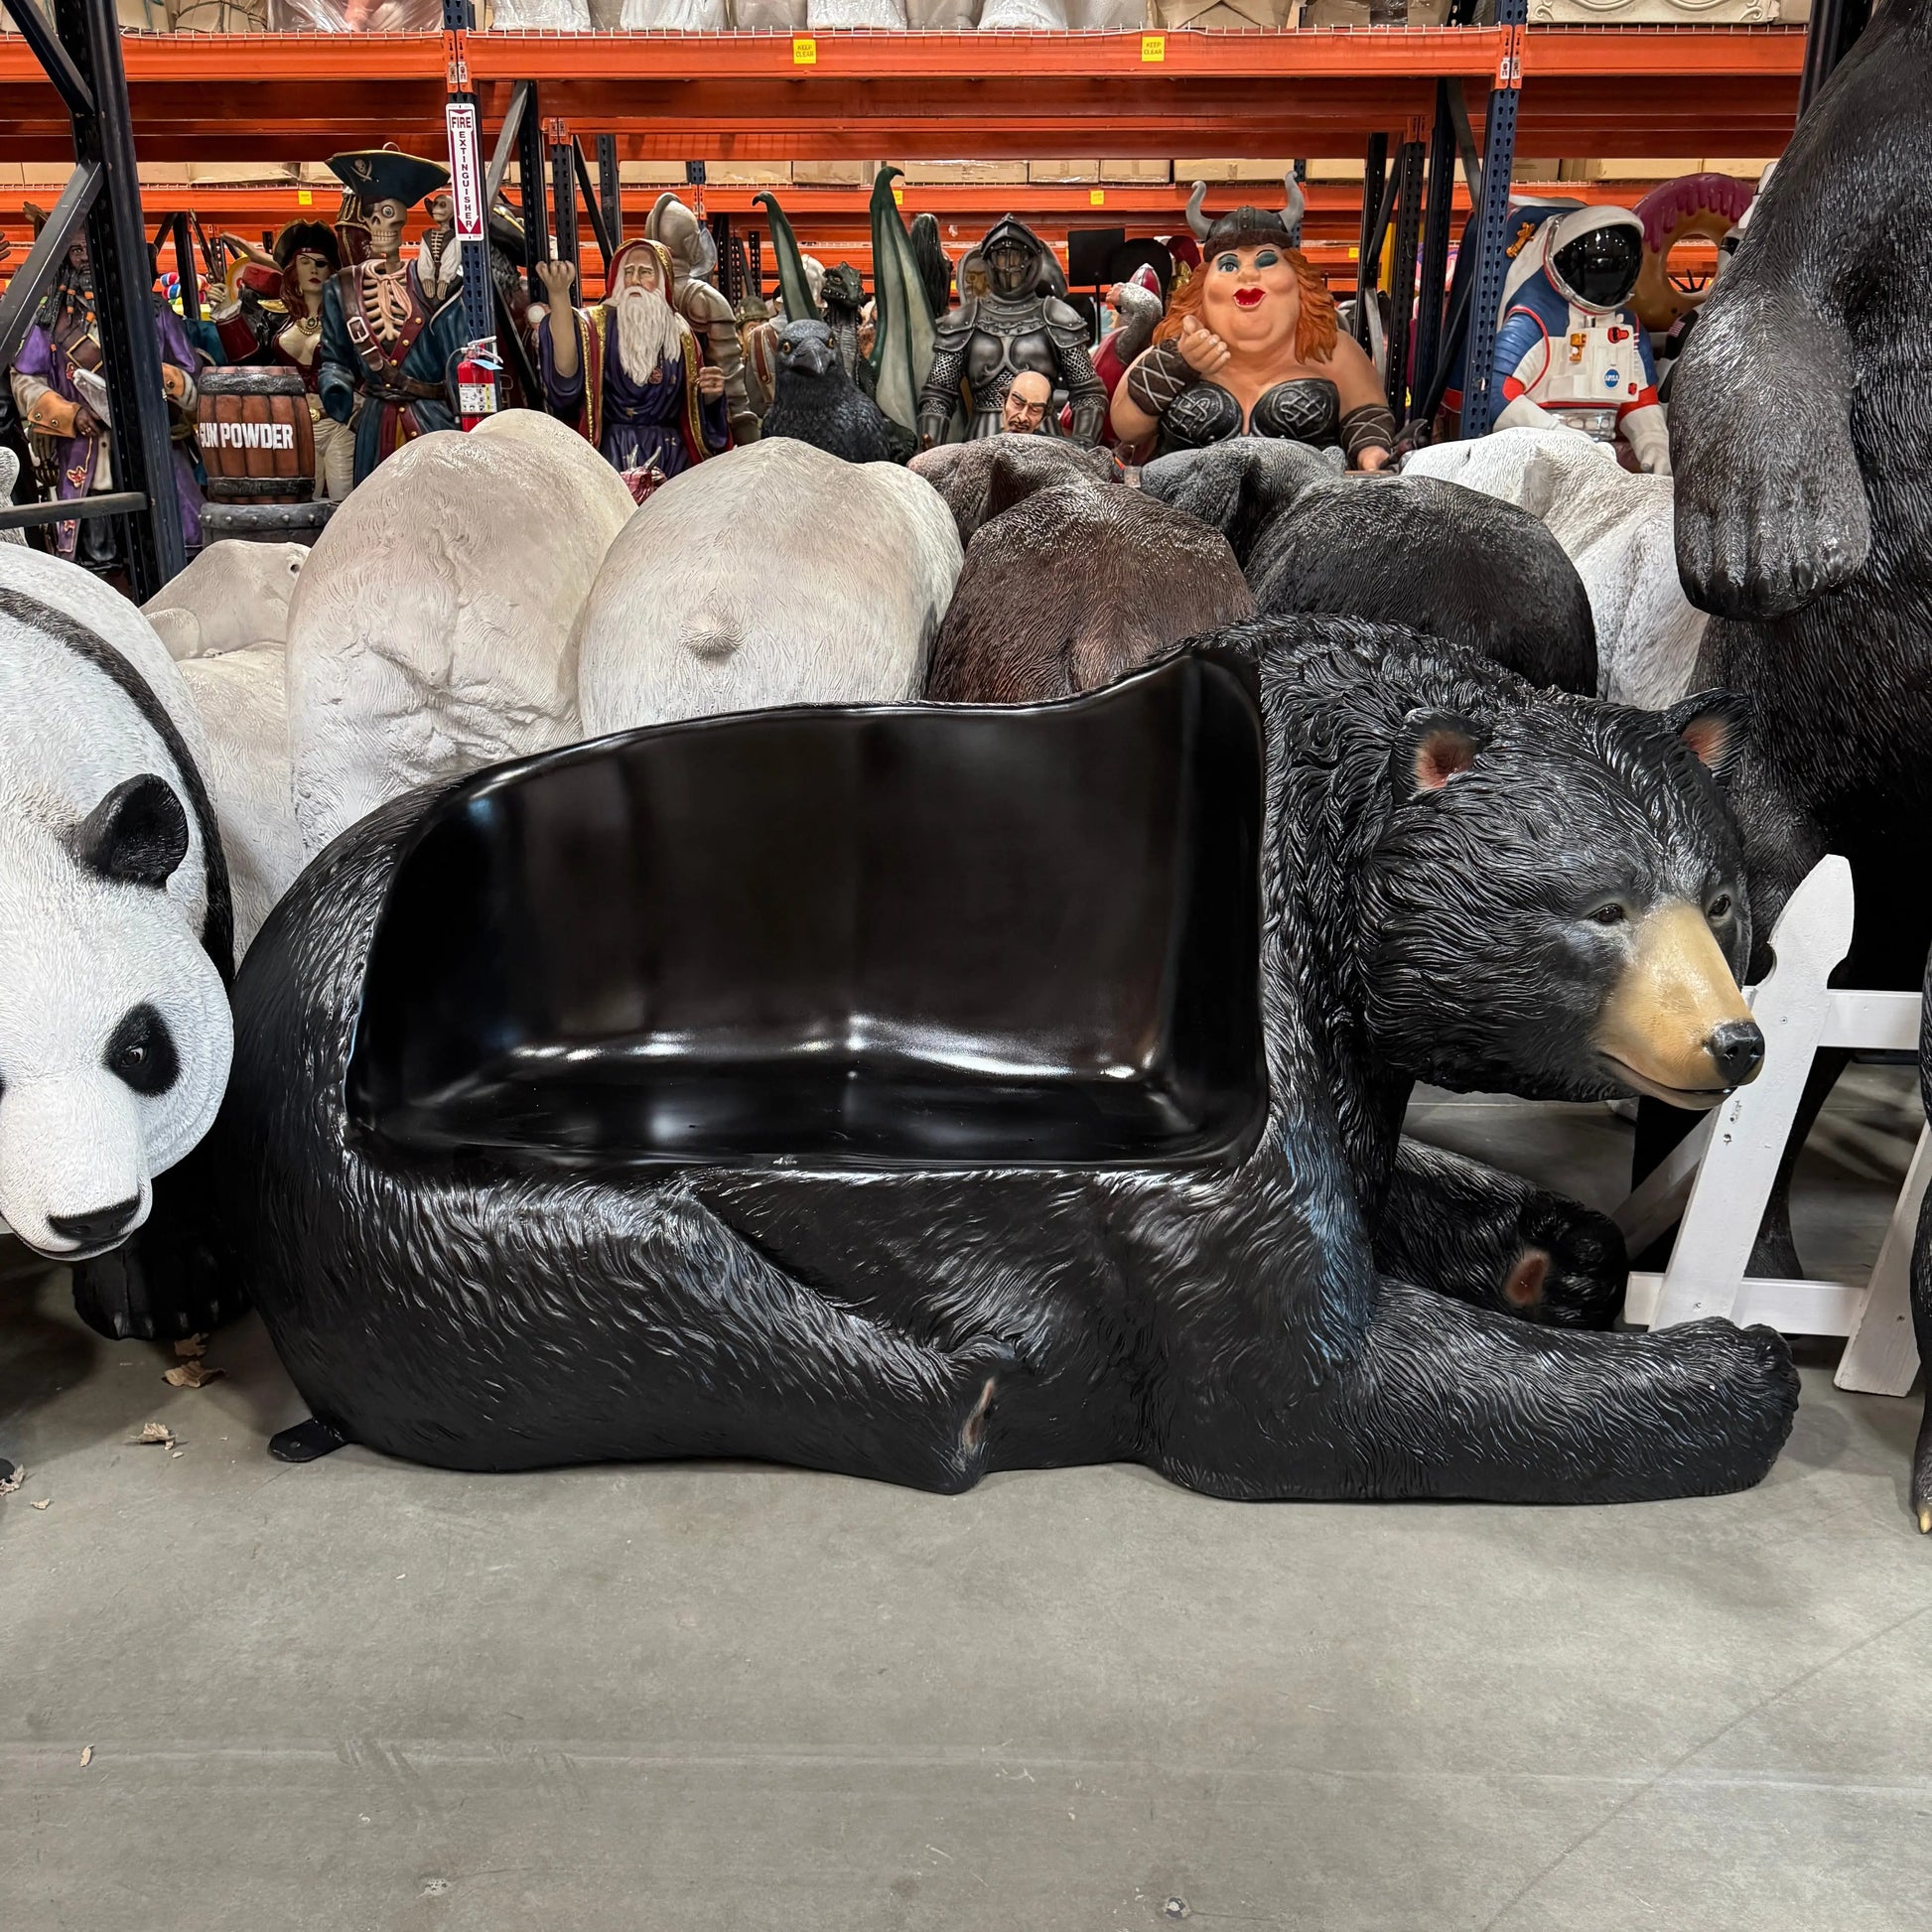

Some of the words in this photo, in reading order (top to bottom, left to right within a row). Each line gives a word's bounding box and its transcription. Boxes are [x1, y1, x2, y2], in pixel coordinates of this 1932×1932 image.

[451, 116, 472, 129] FIRE
[459, 131, 473, 227] EXTINGUISHER
[200, 422, 218, 448] GUN
[219, 422, 294, 449] POWDER
